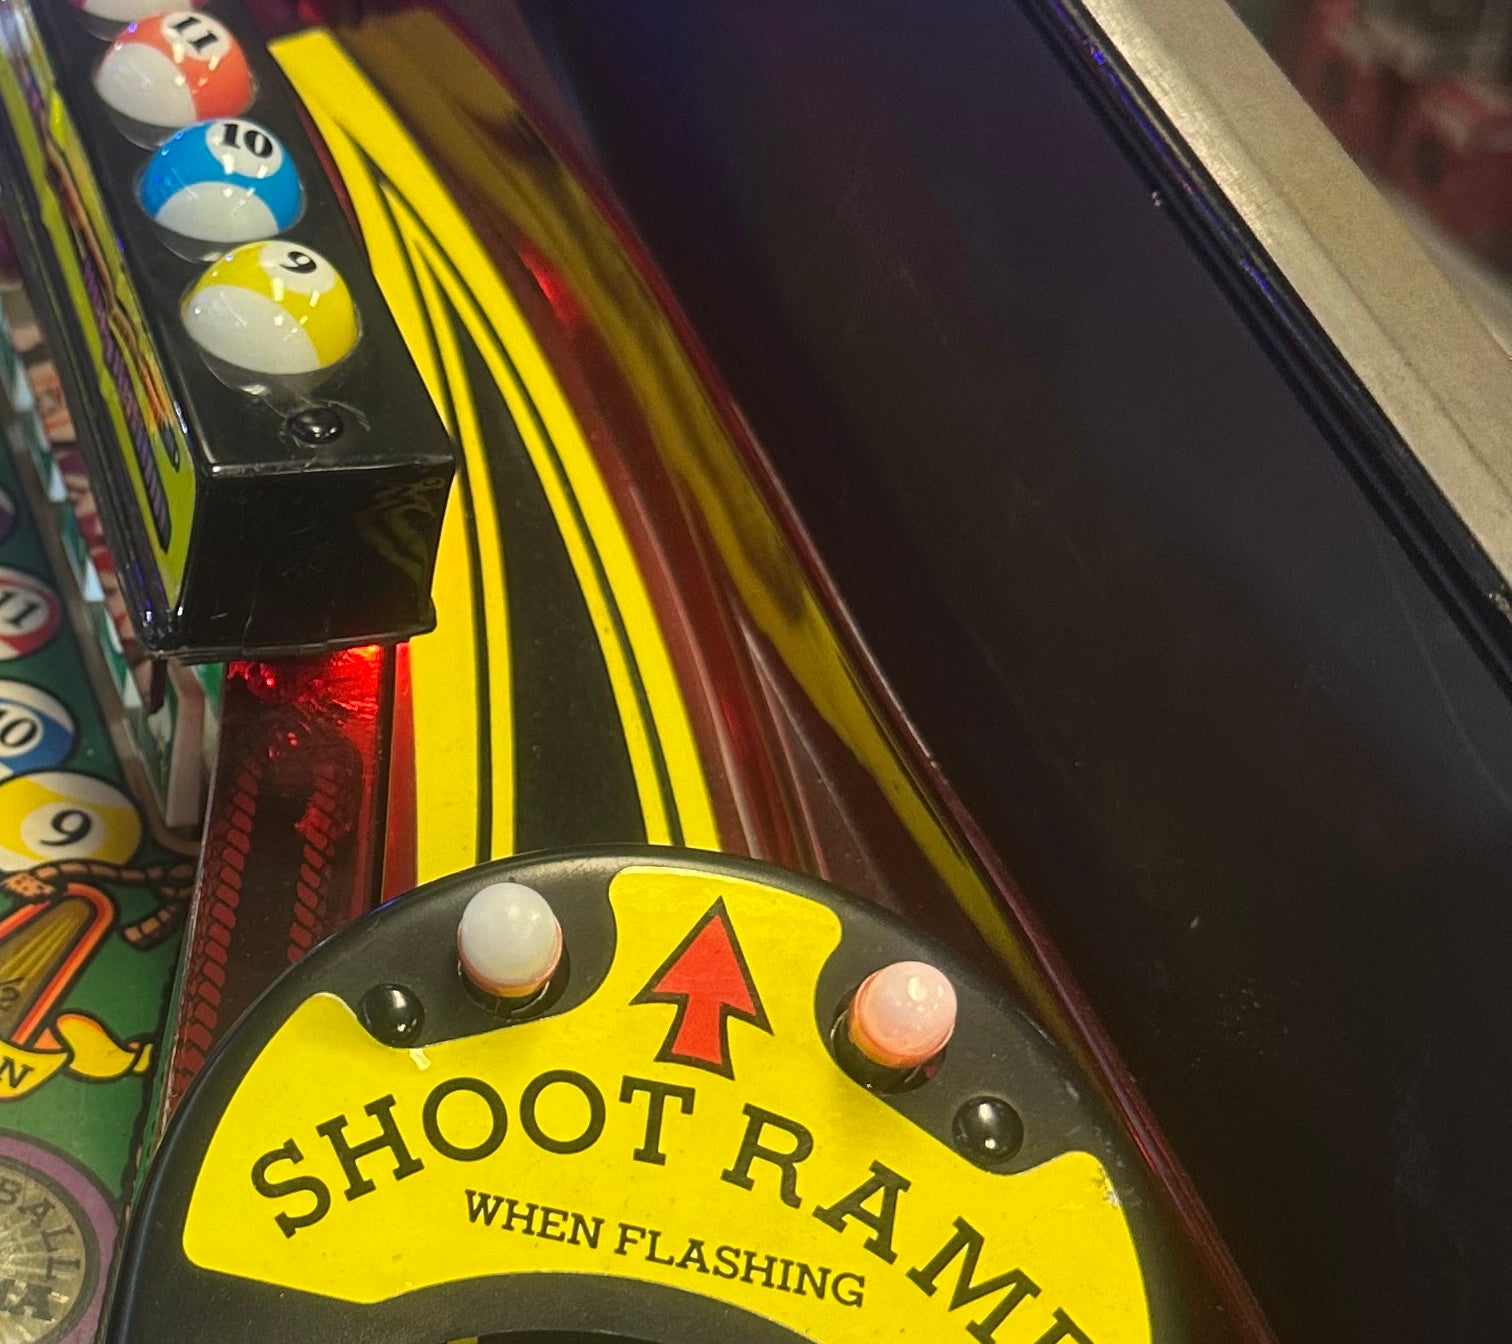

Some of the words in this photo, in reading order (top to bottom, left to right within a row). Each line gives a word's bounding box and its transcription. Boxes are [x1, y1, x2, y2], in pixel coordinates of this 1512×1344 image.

[172, 15, 220, 54] 11
[220, 122, 274, 160] 10
[279, 250, 318, 276] 9
[39, 807, 93, 849] 9
[250, 1068, 696, 1239] SHOOT
[464, 1188, 605, 1250] WHEN
[613, 1221, 867, 1309] FLASHING
